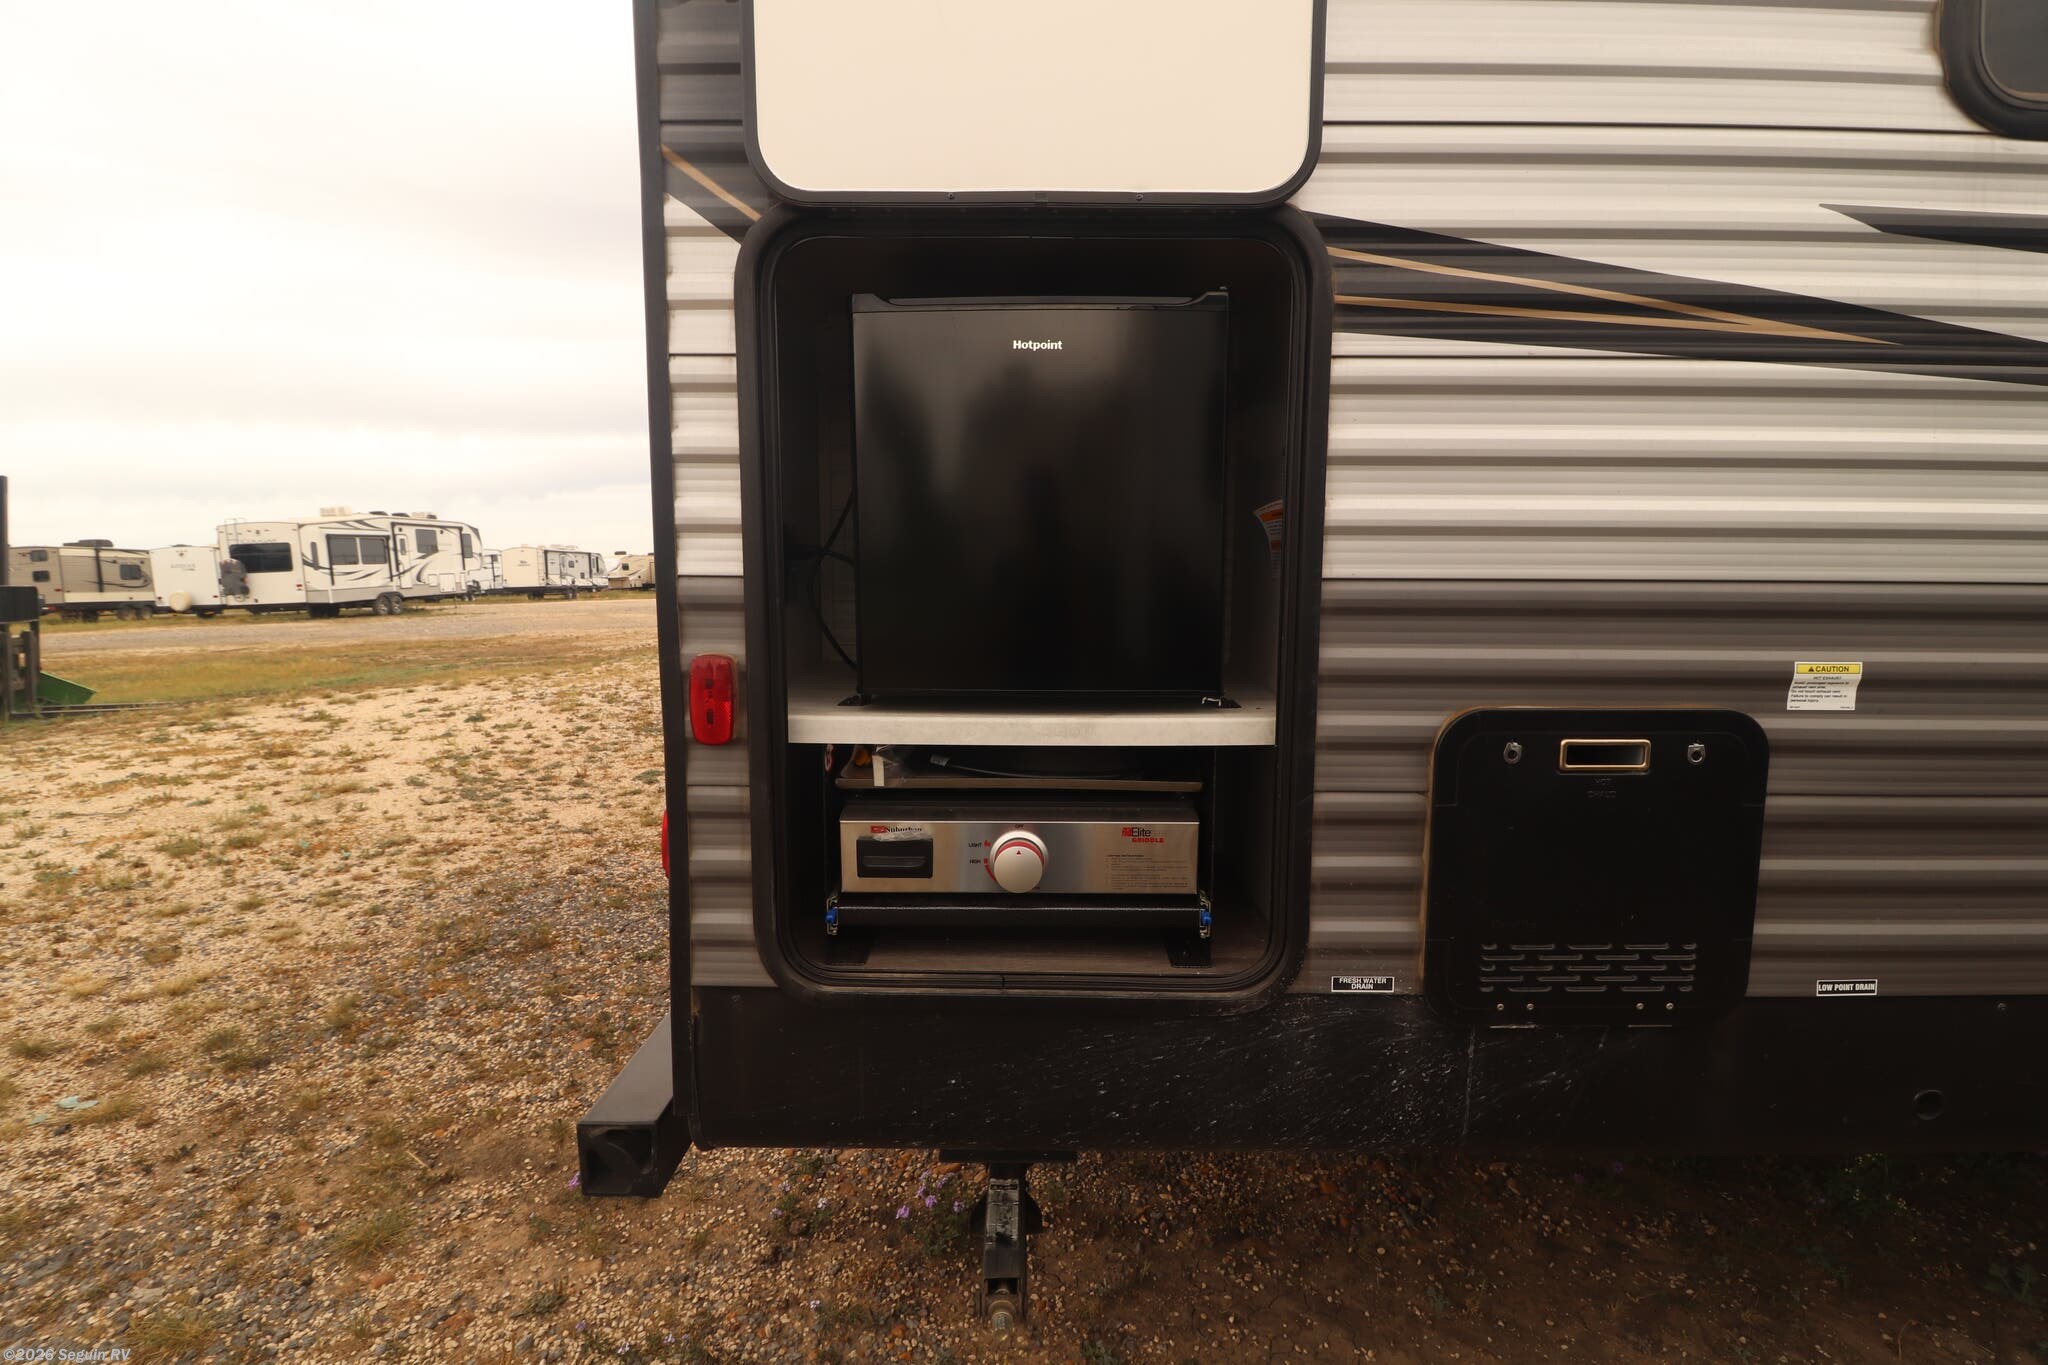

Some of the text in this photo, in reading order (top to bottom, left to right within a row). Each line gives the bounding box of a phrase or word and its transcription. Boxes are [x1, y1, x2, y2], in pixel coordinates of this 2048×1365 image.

[1013, 339, 1063, 351] Hotpoint
[1131, 827, 1151, 837] Elite
[1855, 983, 1875, 991] DRAIN
